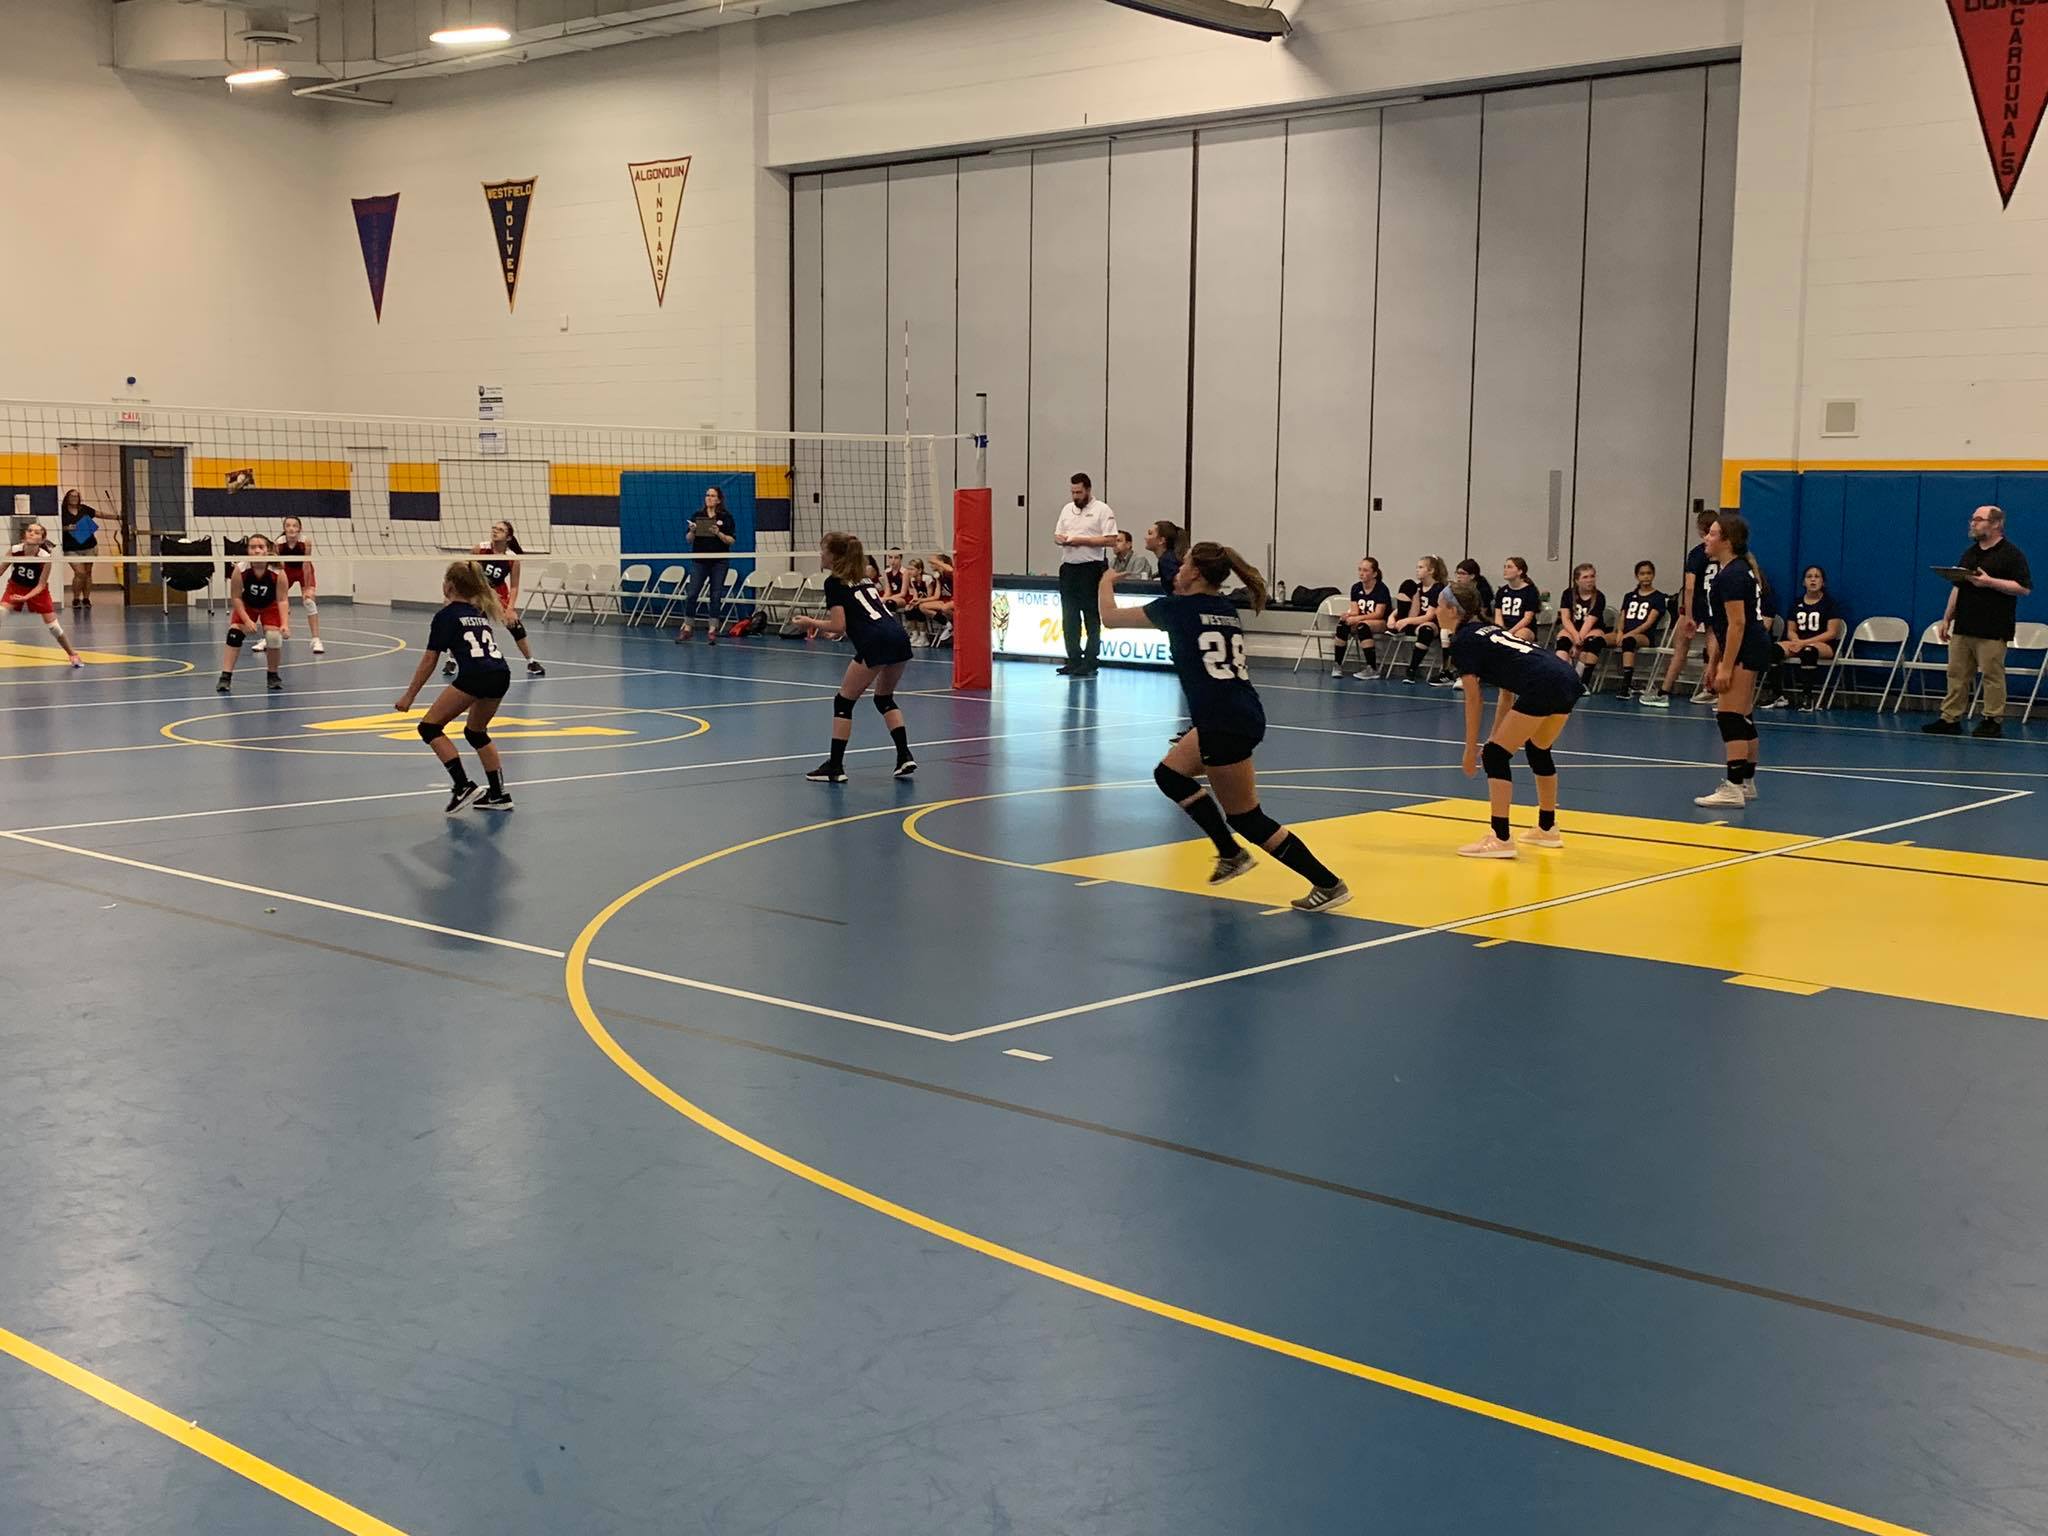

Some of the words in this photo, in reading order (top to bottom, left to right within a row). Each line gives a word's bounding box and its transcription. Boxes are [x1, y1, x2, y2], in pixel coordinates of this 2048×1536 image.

[2001, 8, 2025, 176] CARDUNALS
[634, 165, 685, 182] ALGONQUIN
[486, 184, 532, 200] WESTFIELD
[656, 182, 664, 281] INDIANS
[506, 200, 515, 283] WOLVES
[18, 566, 35, 580] 28
[485, 564, 502, 578] 56
[250, 584, 268, 597] 57
[1017, 592, 1049, 607] HOME
[1501, 596, 1522, 616] 22
[1626, 601, 1649, 620] 26
[1099, 639, 1170, 661] WOLVE
[1197, 631, 1249, 680] 28
